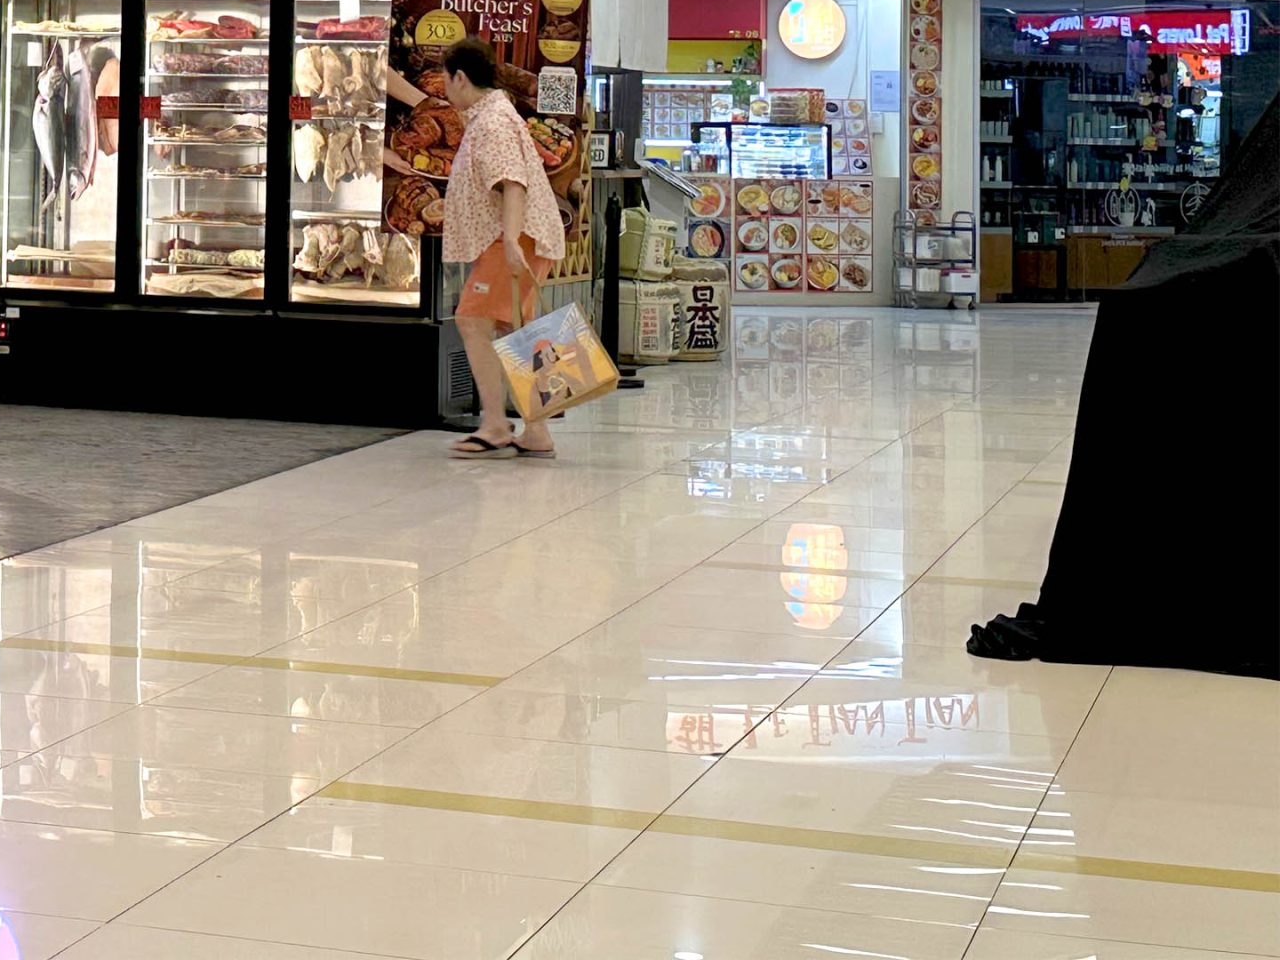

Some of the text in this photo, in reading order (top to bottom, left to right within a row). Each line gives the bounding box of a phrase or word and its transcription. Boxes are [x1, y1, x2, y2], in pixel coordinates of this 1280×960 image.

[479, 13, 528, 33] Feast
[686, 285, 720, 350] 日本盛
